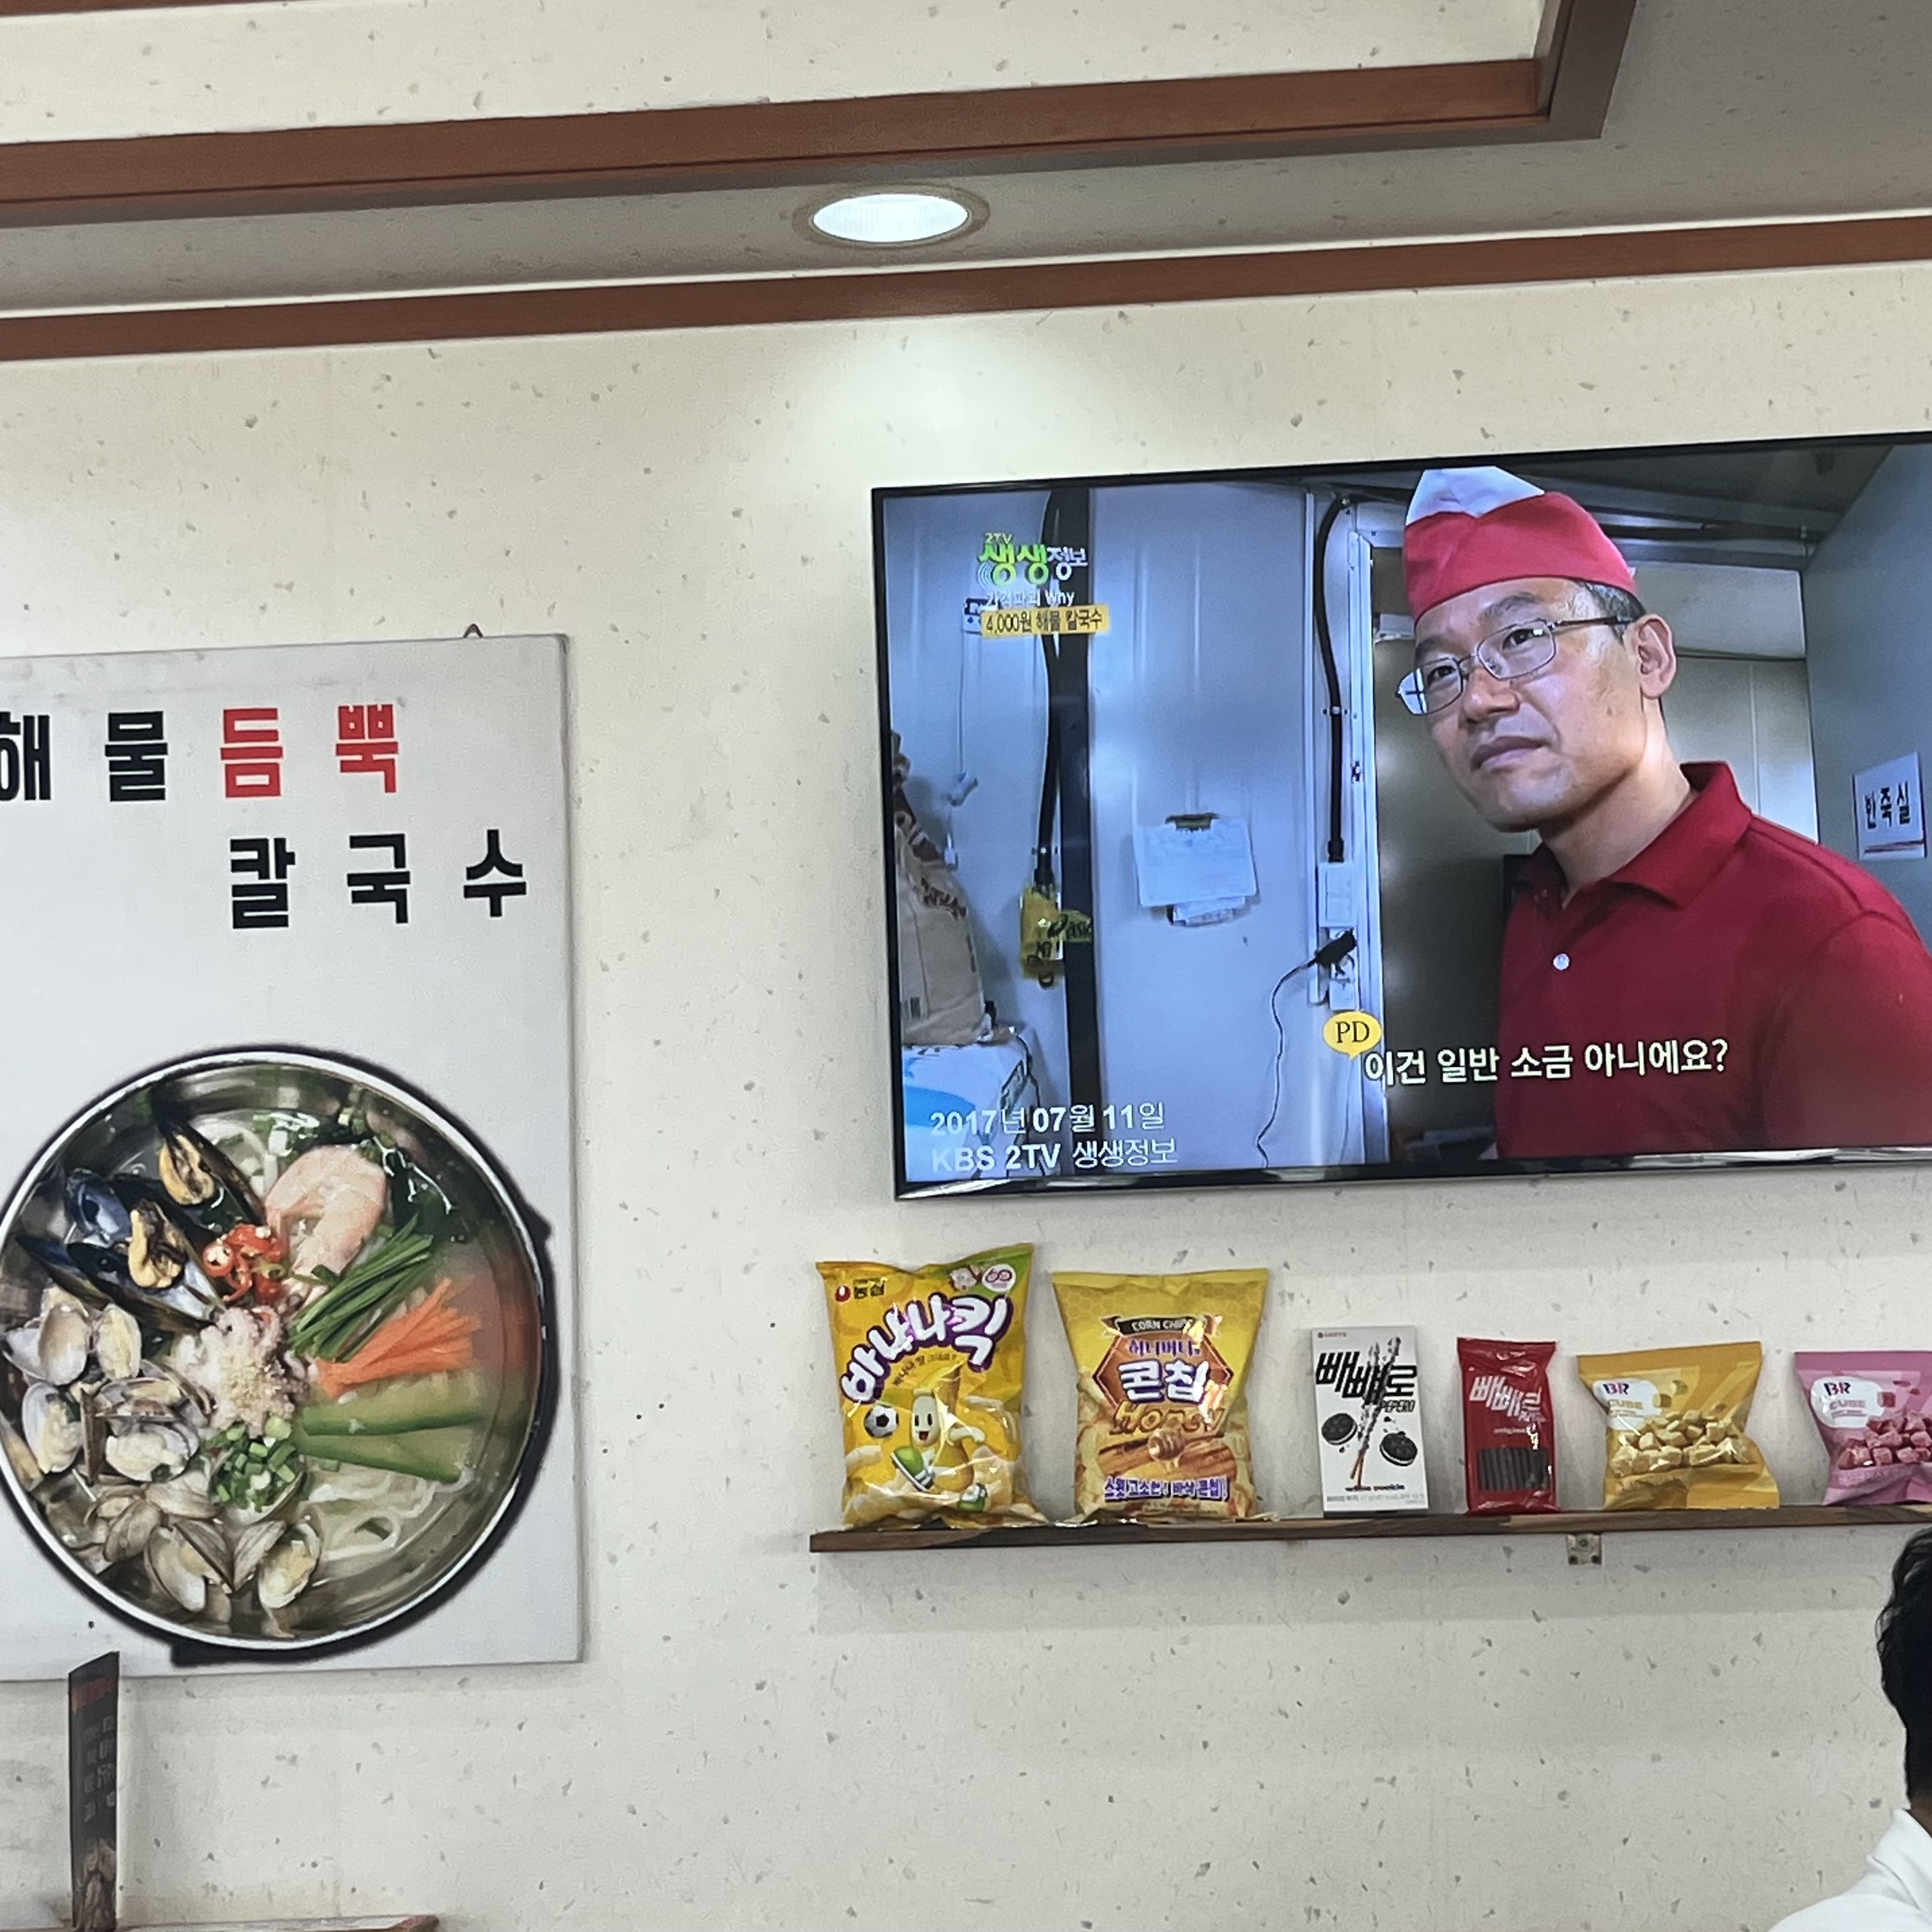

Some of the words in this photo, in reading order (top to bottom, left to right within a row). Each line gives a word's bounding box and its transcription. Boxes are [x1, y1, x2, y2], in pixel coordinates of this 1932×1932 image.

[1045, 588, 1075, 607] Why
[986, 611, 1032, 634] 4,000원
[1066, 608, 1103, 631] 칼국수
[1335, 1020, 1370, 1043] PD
[1365, 1049, 1427, 1085] 이건
[1438, 1048, 1500, 1084] 일반
[1510, 1045, 1574, 1079] 소금
[1584, 1038, 1729, 1077] 아니에요?
[930, 1107, 1027, 1136] 2017년
[1032, 1105, 1095, 1133] 07월
[1103, 1102, 1165, 1130] 11일
[931, 1144, 995, 1174] KBS
[1005, 1143, 1062, 1170] 2TV
[1072, 1138, 1179, 1169] 생생정보
[1131, 1319, 1161, 1332] CORN
[839, 1292, 1013, 1404] 바나나킥
[1117, 1358, 1210, 1404] 콘칩
[1315, 1351, 1418, 1406] 빼빼로
[1602, 1383, 1630, 1396] BR
[1824, 1382, 1851, 1397] BR
